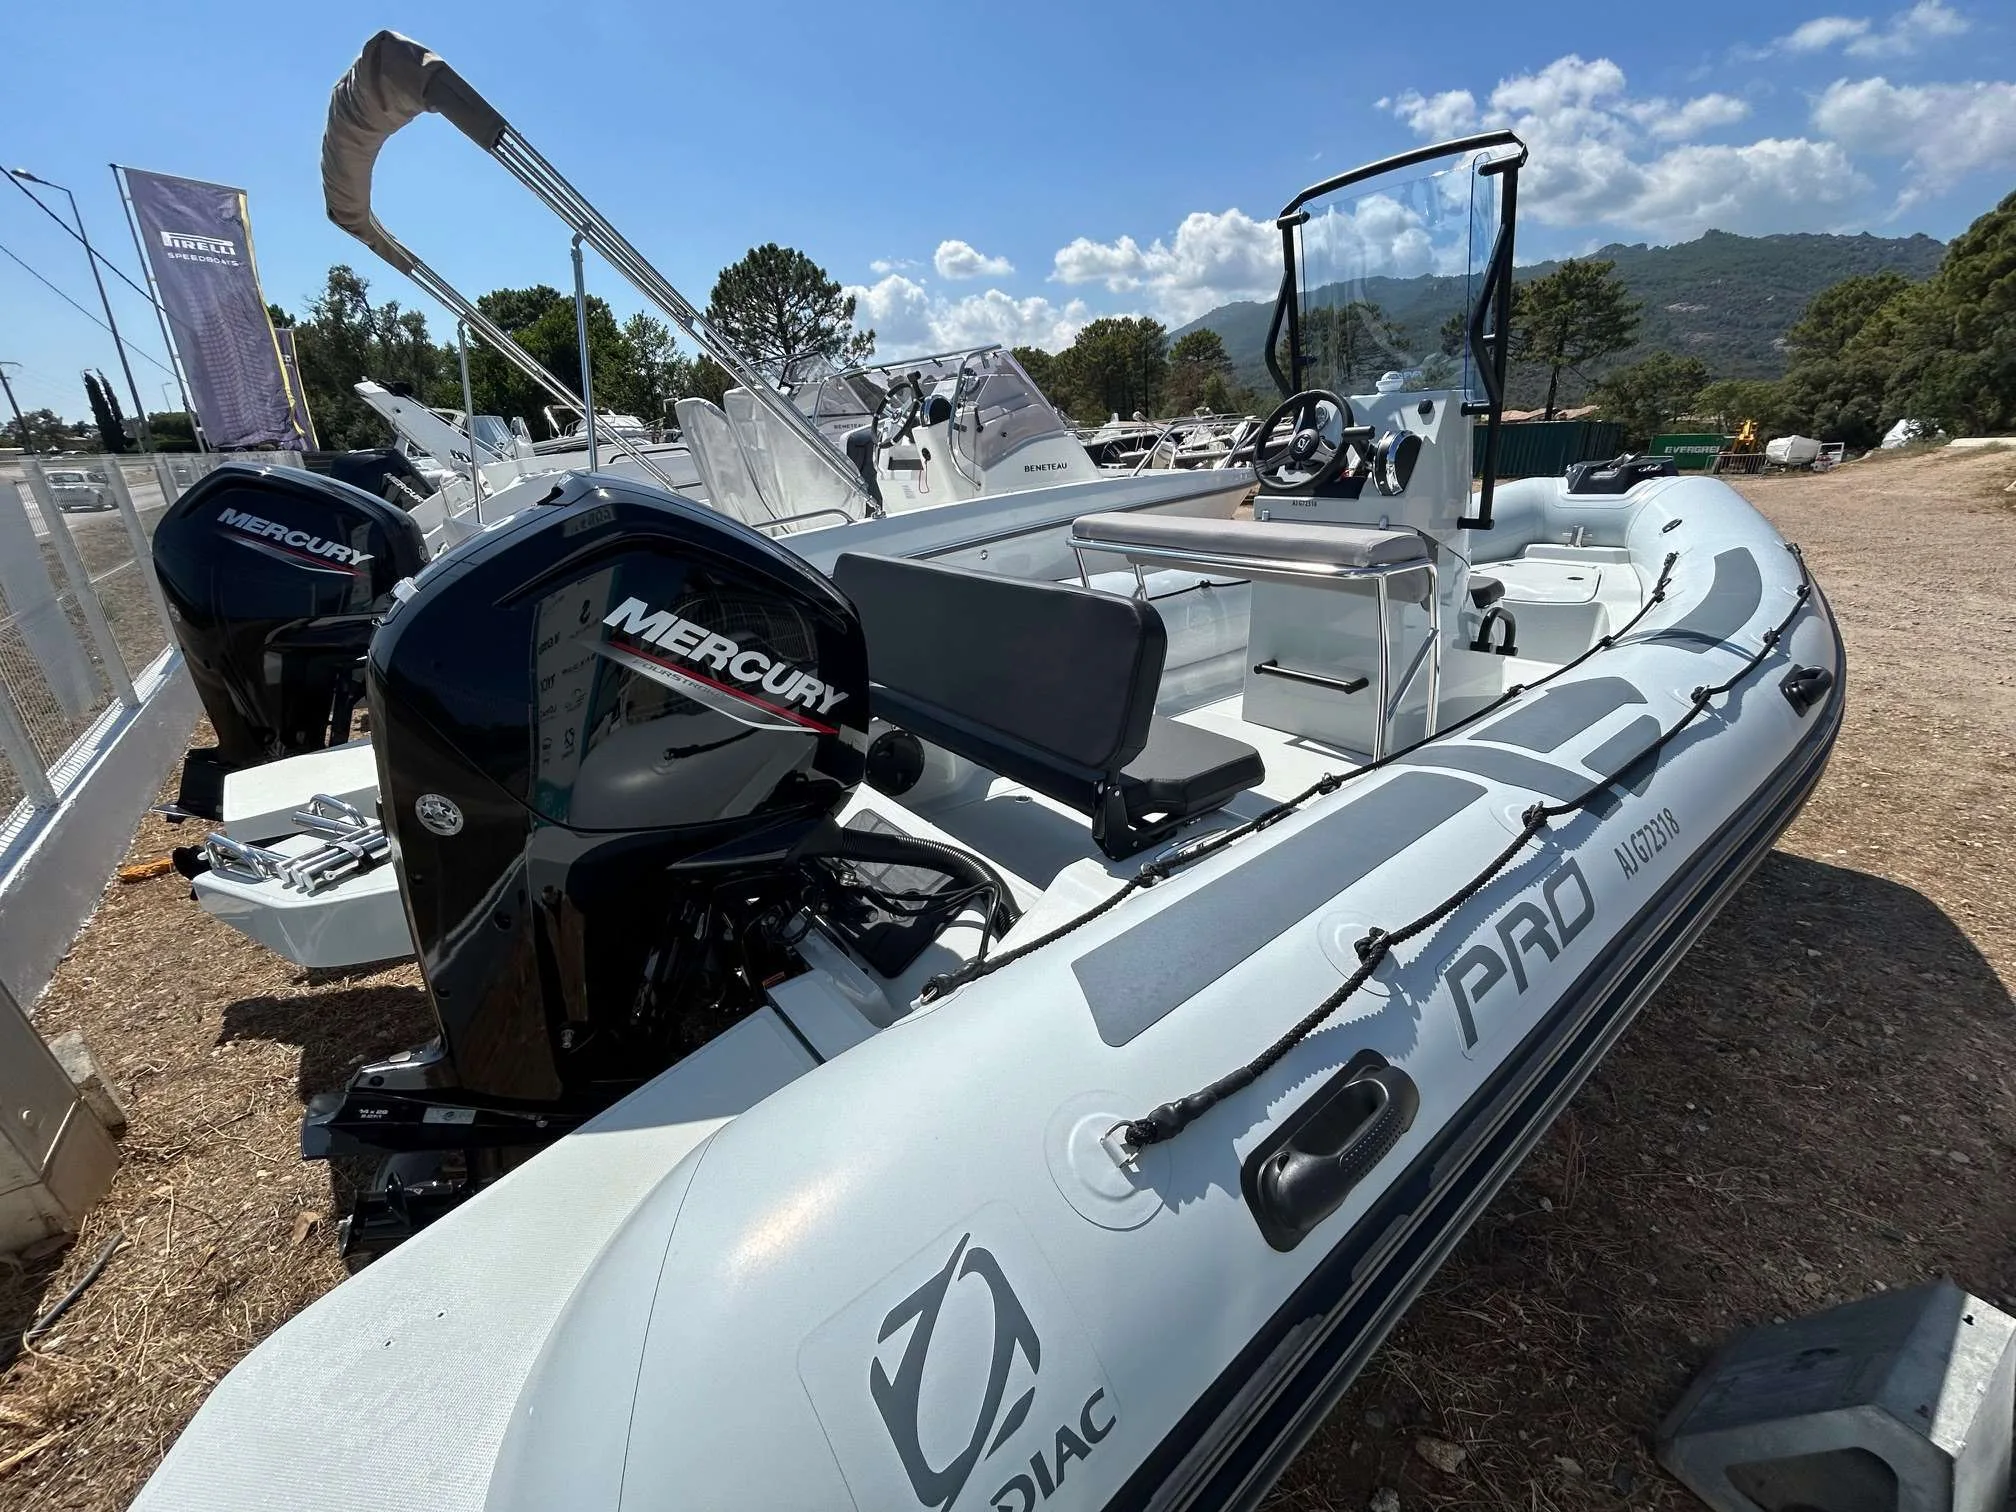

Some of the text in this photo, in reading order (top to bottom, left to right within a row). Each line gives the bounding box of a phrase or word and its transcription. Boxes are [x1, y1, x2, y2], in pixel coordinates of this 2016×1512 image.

[160, 231, 236, 255] PIRELLI
[167, 252, 240, 266] SPEEDBOATS
[1663, 445, 1720, 454] EVERGRE
[1024, 462, 1067, 473] BENETEAU
[383, 471, 425, 503] MERCUR
[217, 507, 375, 566] MERCURY
[602, 597, 849, 714] MERCURY
[1444, 856, 1595, 1050] PRO
